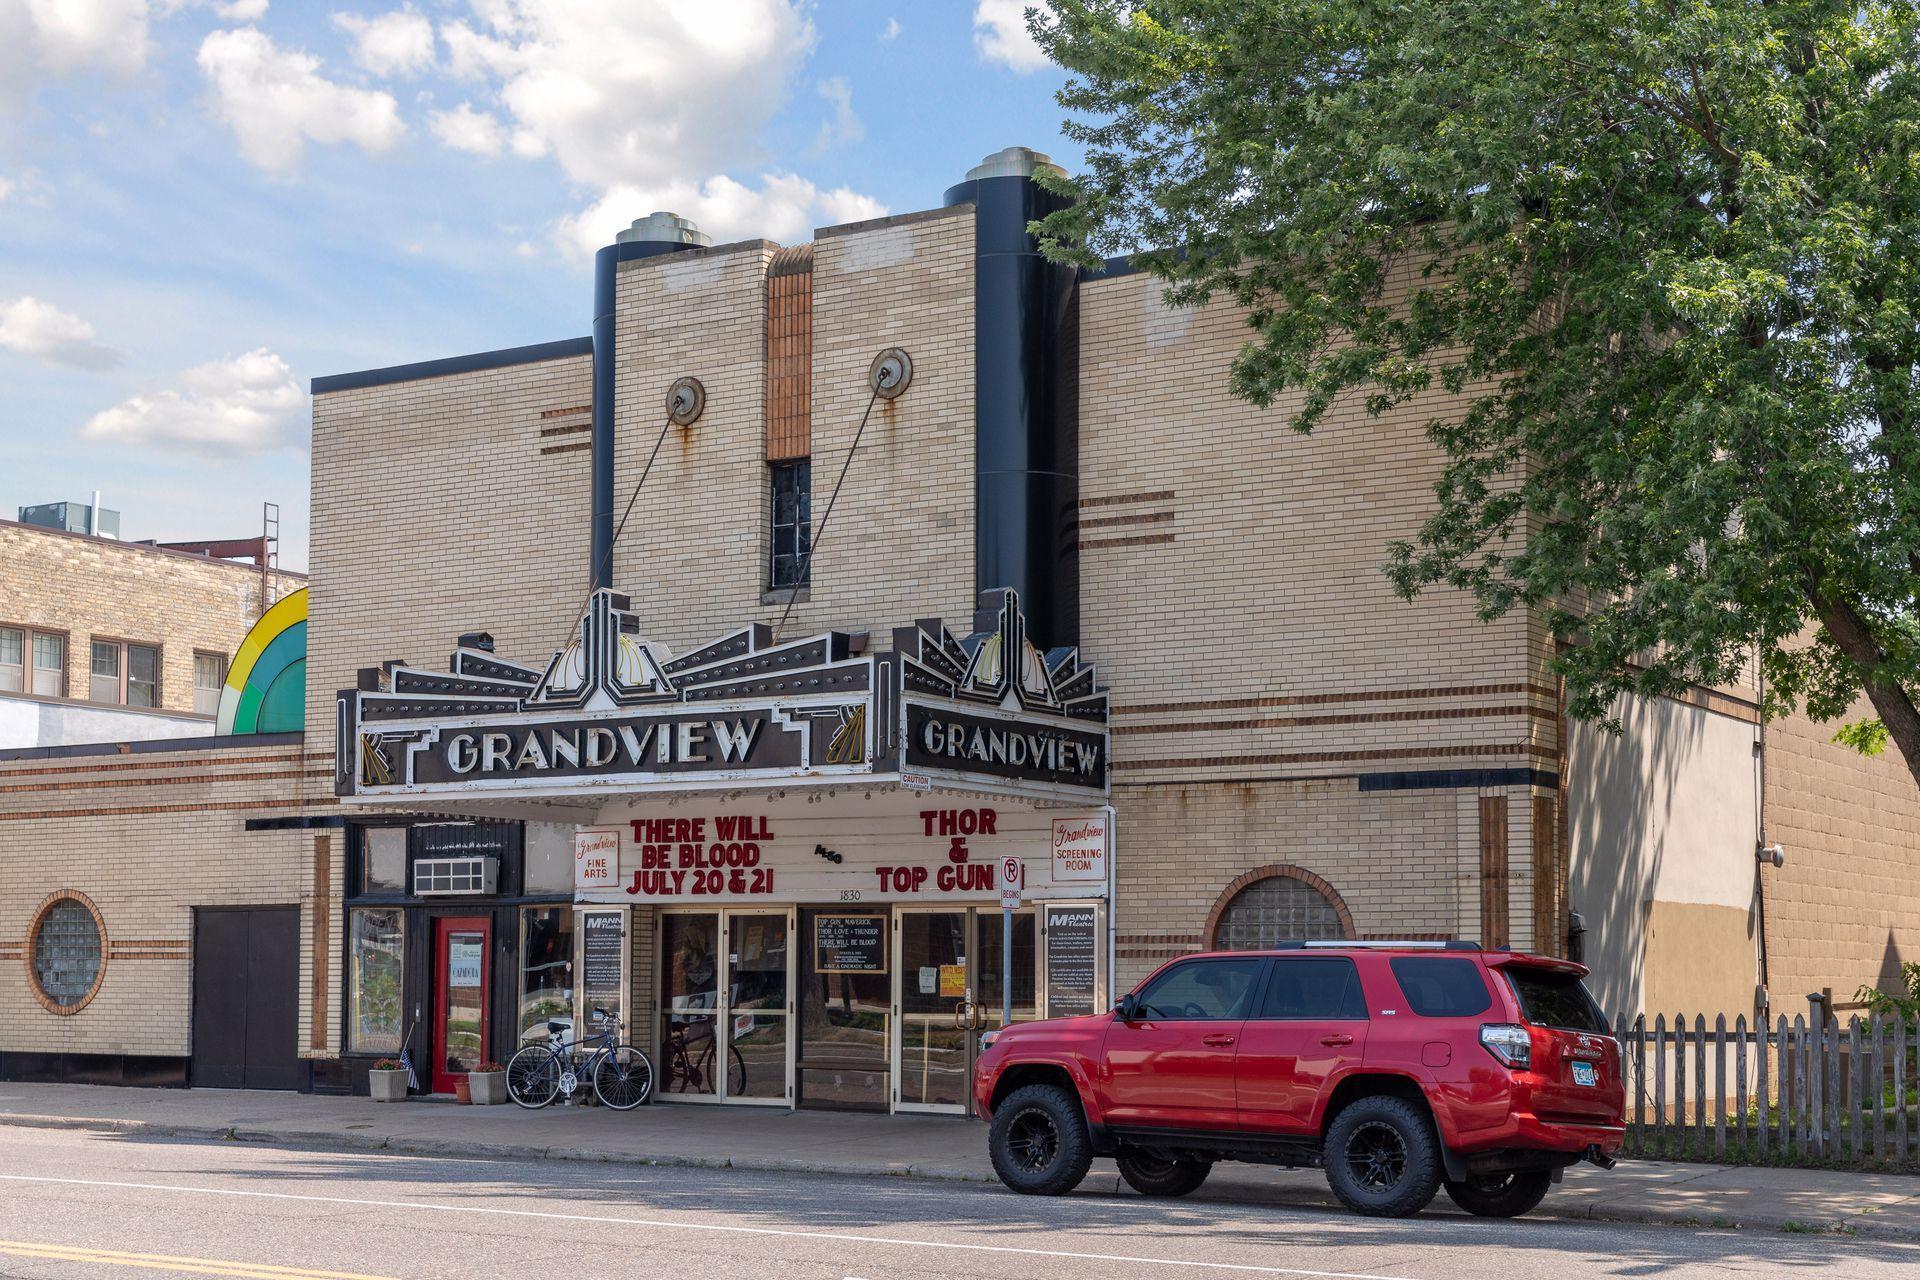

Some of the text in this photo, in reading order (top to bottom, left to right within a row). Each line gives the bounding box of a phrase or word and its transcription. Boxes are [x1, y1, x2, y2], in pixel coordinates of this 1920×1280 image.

[447, 718, 763, 774] GRANDVIEW
[922, 719, 1098, 776] GRANDVIEW
[903, 775, 928, 785] CAUTION
[630, 816, 775, 843] THERE WILL
[919, 808, 997, 836] THOR
[1054, 822, 1104, 847] Grandview
[641, 843, 760, 869] BE BLOOD
[814, 844, 842, 864] ALSO
[948, 837, 969, 863] &
[1056, 848, 1102, 860] SCREENING
[587, 859, 607, 868] FINE
[1065, 860, 1092, 871] ROOM
[583, 869, 608, 879] ARTS
[626, 868, 774, 895] JULY 20 & 21
[875, 866, 928, 892] TOP
[937, 864, 995, 891] GUN
[840, 890, 861, 901] 1830
[1003, 889, 1020, 899] BEGINS
[586, 917, 621, 929] MANN
[1049, 914, 1094, 927] MANN
